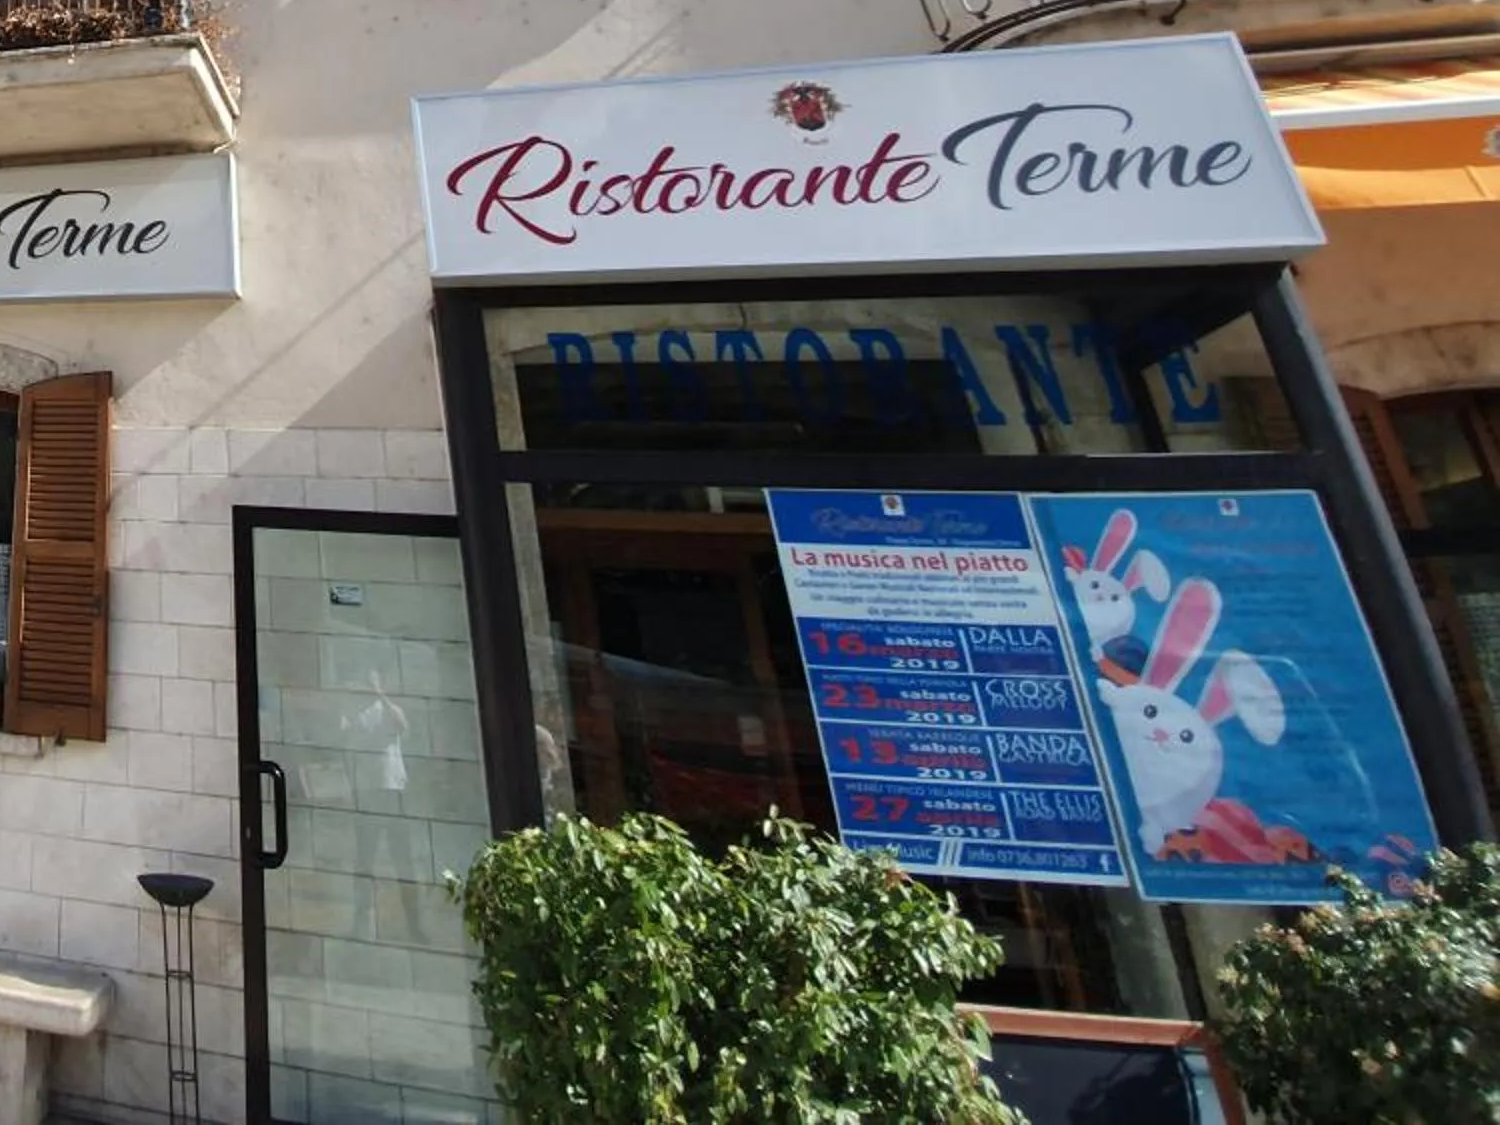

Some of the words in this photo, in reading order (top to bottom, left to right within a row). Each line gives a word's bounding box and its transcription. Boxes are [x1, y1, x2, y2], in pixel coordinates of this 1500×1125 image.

[446, 133, 940, 246] Ristorante
[940, 102, 1252, 211] Terme
[546, 324, 1221, 431] RISTORANTE
[791, 546, 818, 566] La
[824, 550, 907, 570] musica
[912, 552, 950, 570] nel
[955, 553, 1029, 575] piatto
[808, 631, 867, 656] 16
[884, 636, 956, 648] sabato
[968, 626, 1053, 646] DALLA
[890, 657, 961, 671] 2019
[821, 682, 879, 709] 23
[900, 689, 972, 702] sabato
[985, 678, 1067, 698] CROSS
[905, 710, 977, 724] 2019
[909, 742, 982, 755] sabato
[995, 733, 1088, 755] BANDA
[915, 766, 987, 781] 2019
[851, 794, 910, 822] 27
[923, 799, 996, 812] sabato
[1008, 790, 1051, 809] THE
[928, 824, 1001, 838] 2019
